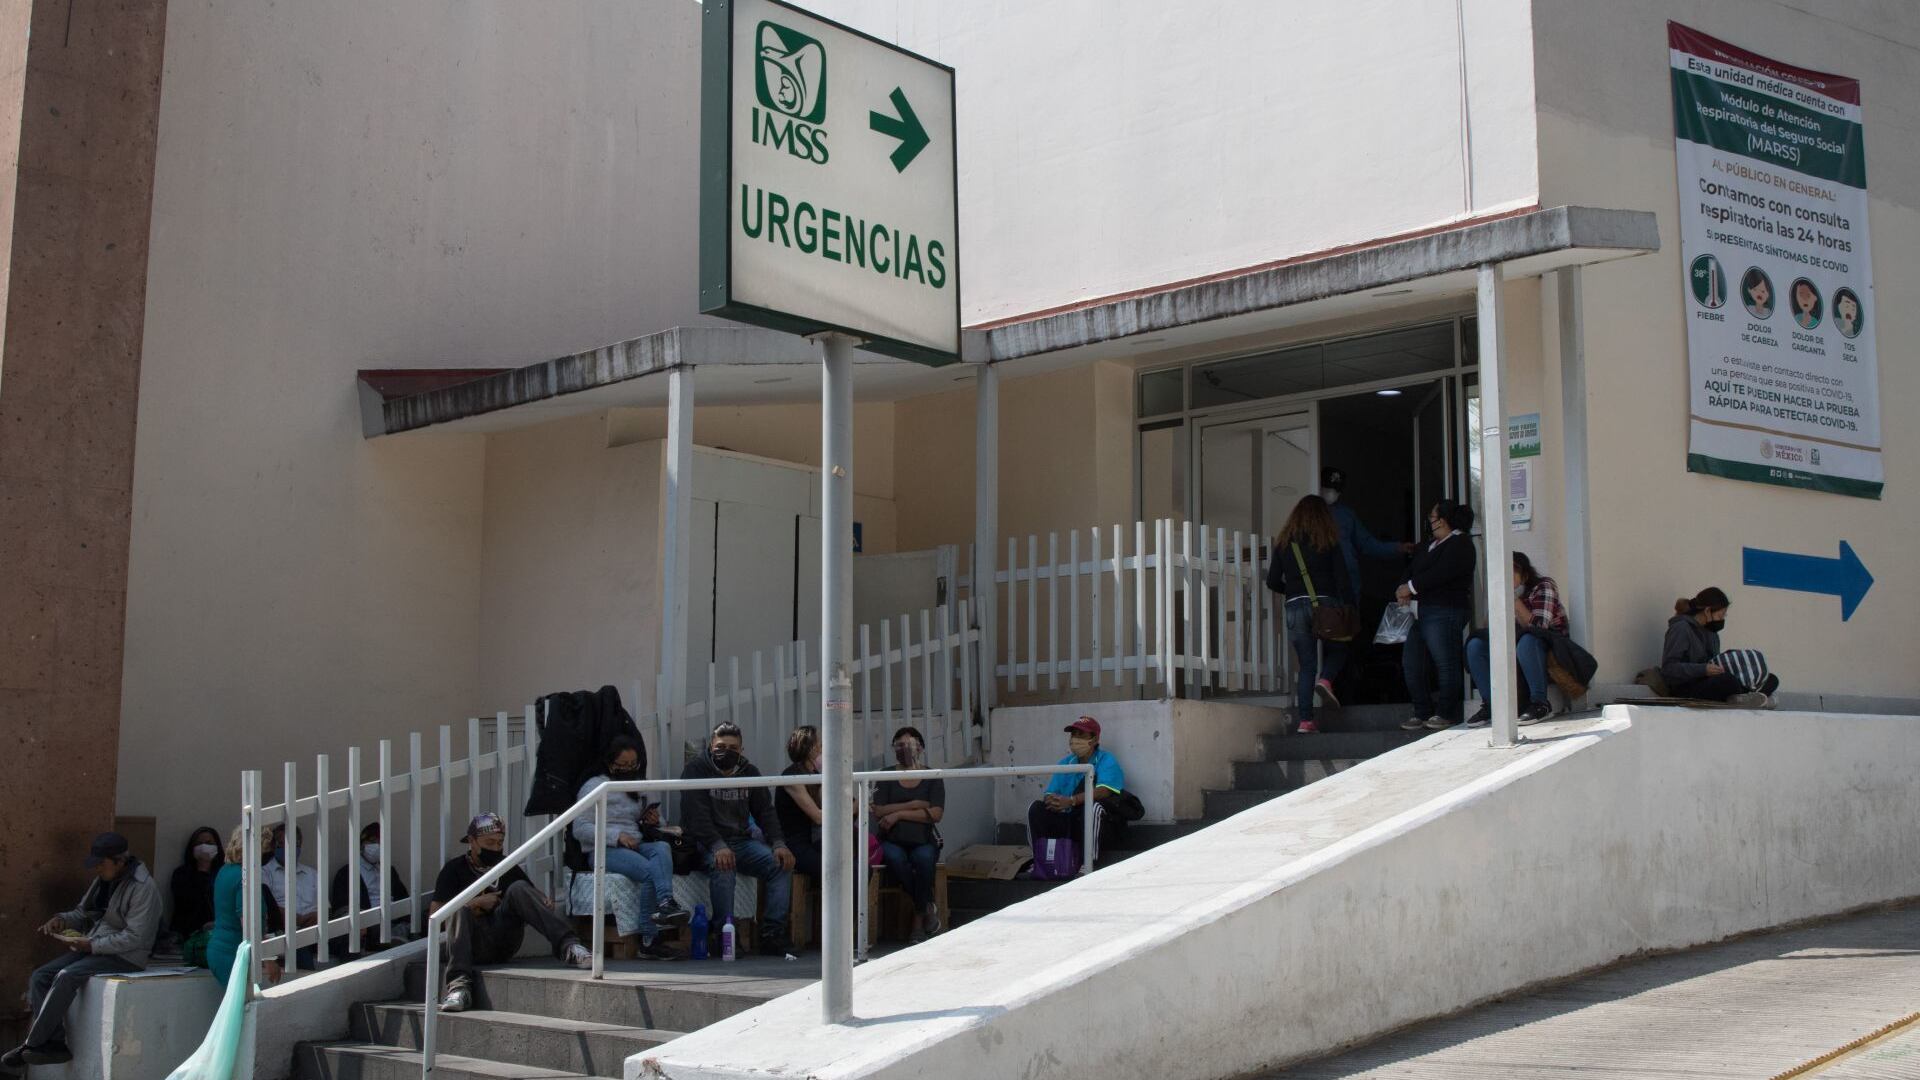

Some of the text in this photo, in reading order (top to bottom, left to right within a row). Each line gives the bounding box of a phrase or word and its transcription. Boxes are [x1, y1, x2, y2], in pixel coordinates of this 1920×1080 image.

[1688, 58, 1845, 116] Esta unidad médica cuenta con
[1696, 101, 1845, 154] Respiratoria del Seguro Social
[1720, 92, 1820, 131] Módulo de Atención
[752, 107, 829, 164] IMSS
[1748, 133, 1800, 166] (MARSS)
[1712, 158, 1724, 172] AL
[1726, 162, 1771, 184] PÚBLICO
[1774, 176, 1786, 190] EN
[1699, 177, 1850, 230] Contamos con consulta
[742, 184, 946, 289] URGENCIAS
[1700, 202, 1852, 252] respiratoria las 24 horas
[1714, 232, 1764, 253] PRESENTAS
[1765, 244, 1808, 264] SÍNTOMAS
[1810, 256, 1820, 267] DE
[1822, 260, 1848, 273] COVID
[1697, 311, 1725, 322] FIEBRE
[1747, 323, 1772, 334] DOLOR
[1752, 335, 1778, 347] CABEZA
[1704, 380, 1860, 418] AQUÍ TE PUEDEN HACER LA PRUEBA
[1708, 394, 1748, 411] RÁPIDA
[1750, 402, 1772, 416] PARA
[1774, 407, 1818, 424] DETECTAR
